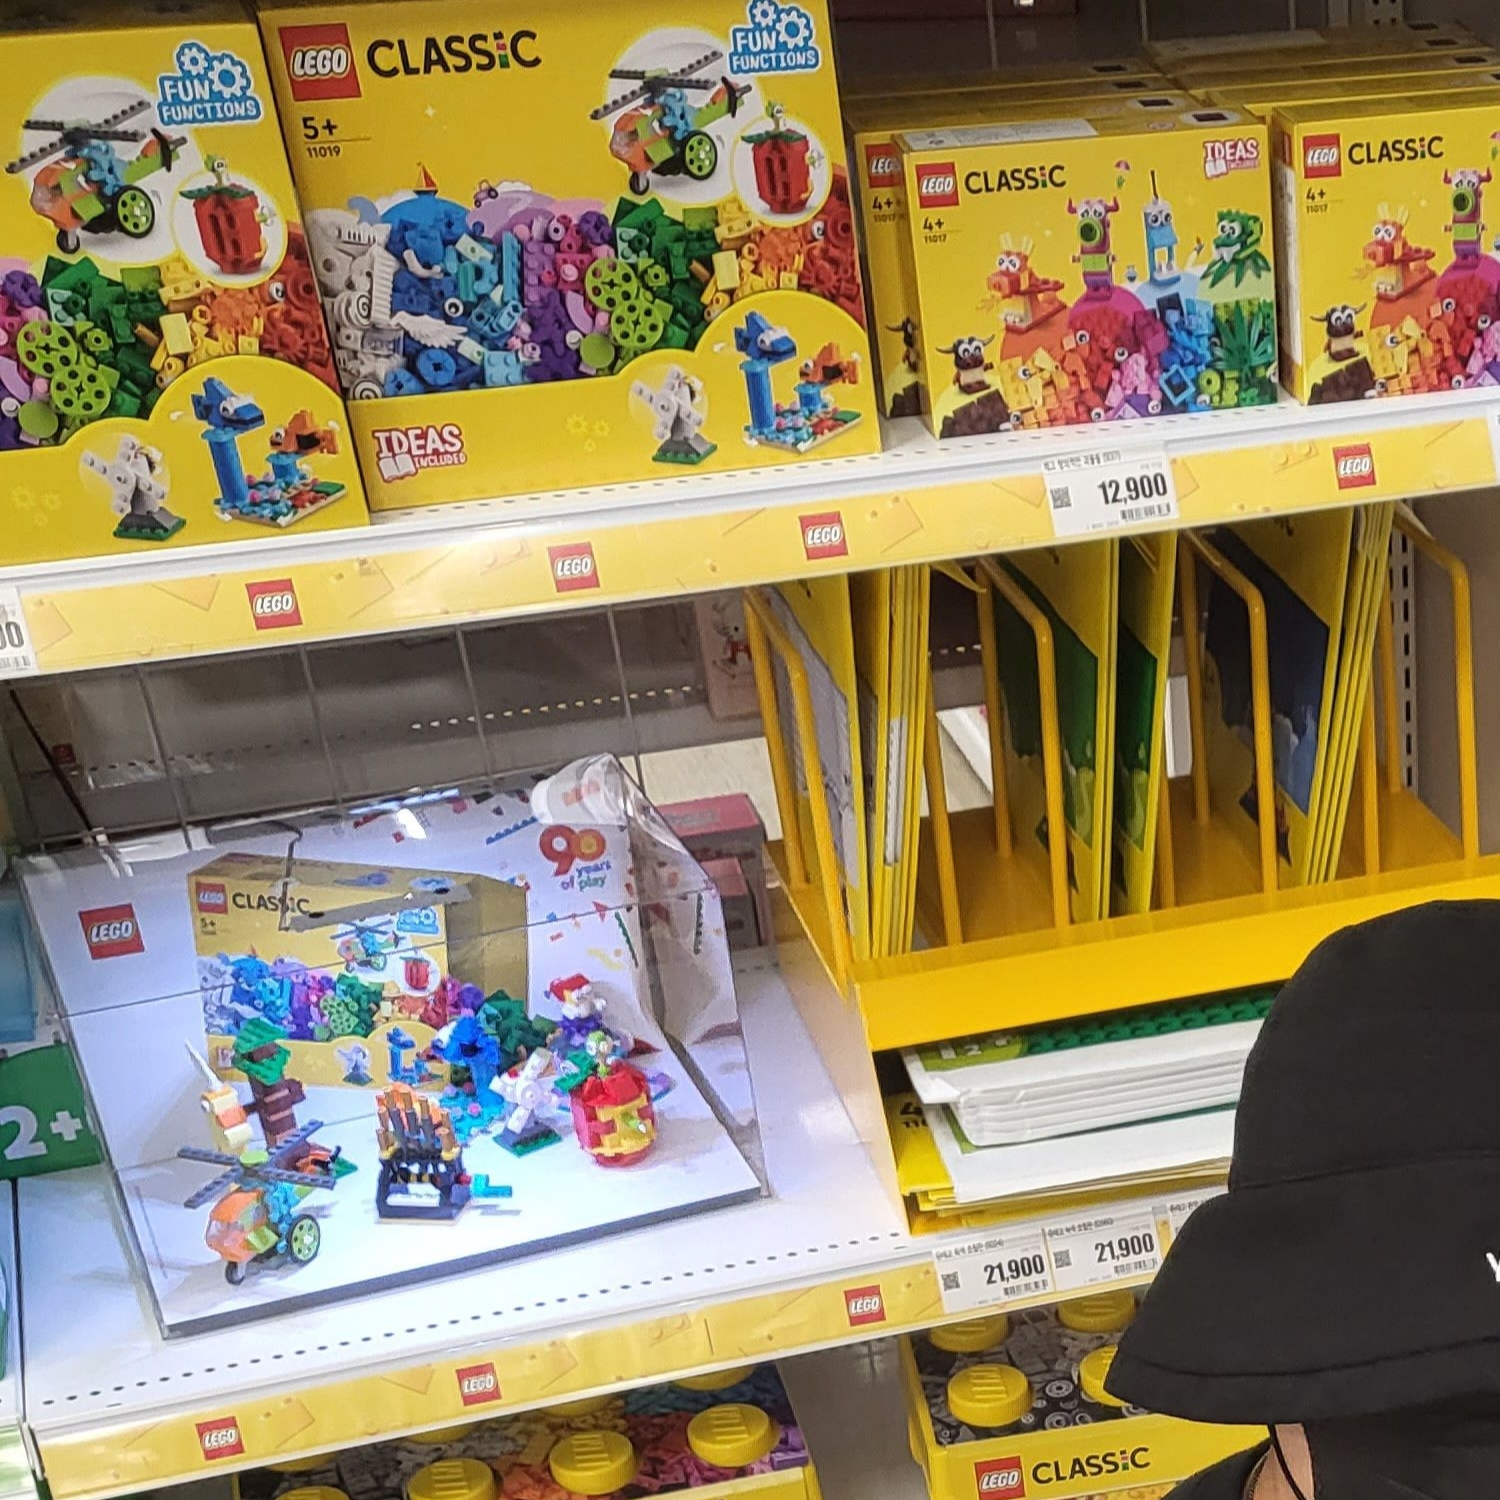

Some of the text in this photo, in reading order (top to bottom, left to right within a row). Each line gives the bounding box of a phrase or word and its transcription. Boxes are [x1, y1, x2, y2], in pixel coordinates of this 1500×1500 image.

[735, 28, 779, 52] FUN
[290, 29, 543, 78] LEGO CLASSIC
[731, 50, 818, 72] FUNCTIONS
[162, 80, 211, 102] FUN
[161, 100, 258, 123] FUNCTIONS
[303, 117, 339, 140] 5+
[305, 144, 341, 159] 11019
[1203, 139, 1260, 162] IDEAS
[1306, 136, 1445, 167] LEGO CLASSIC
[919, 165, 1068, 195] LEGO CLASSIC
[1305, 188, 1327, 202] 4+
[922, 217, 945, 232] 4+
[375, 427, 463, 459] IDEAS
[412, 451, 468, 469] INCLUDED
[1338, 455, 1371, 477] LEGO
[1097, 472, 1169, 506] 12,900
[805, 526, 843, 547] LEGO
[554, 556, 594, 577] LEGO
[254, 592, 294, 615] LEGO
[575, 860, 612, 877] years
[559, 875, 608, 893] of play
[198, 891, 226, 905] LEGO
[89, 917, 134, 943] LEGO
[1094, 1232, 1156, 1265] 21,900
[982, 1253, 1046, 1287] 21,900
[847, 1296, 881, 1316] LEGO
[462, 1372, 496, 1393] LEGO
[202, 1429, 238, 1450] LEGO
[981, 1446, 1152, 1490] LEGO CLASSIC
